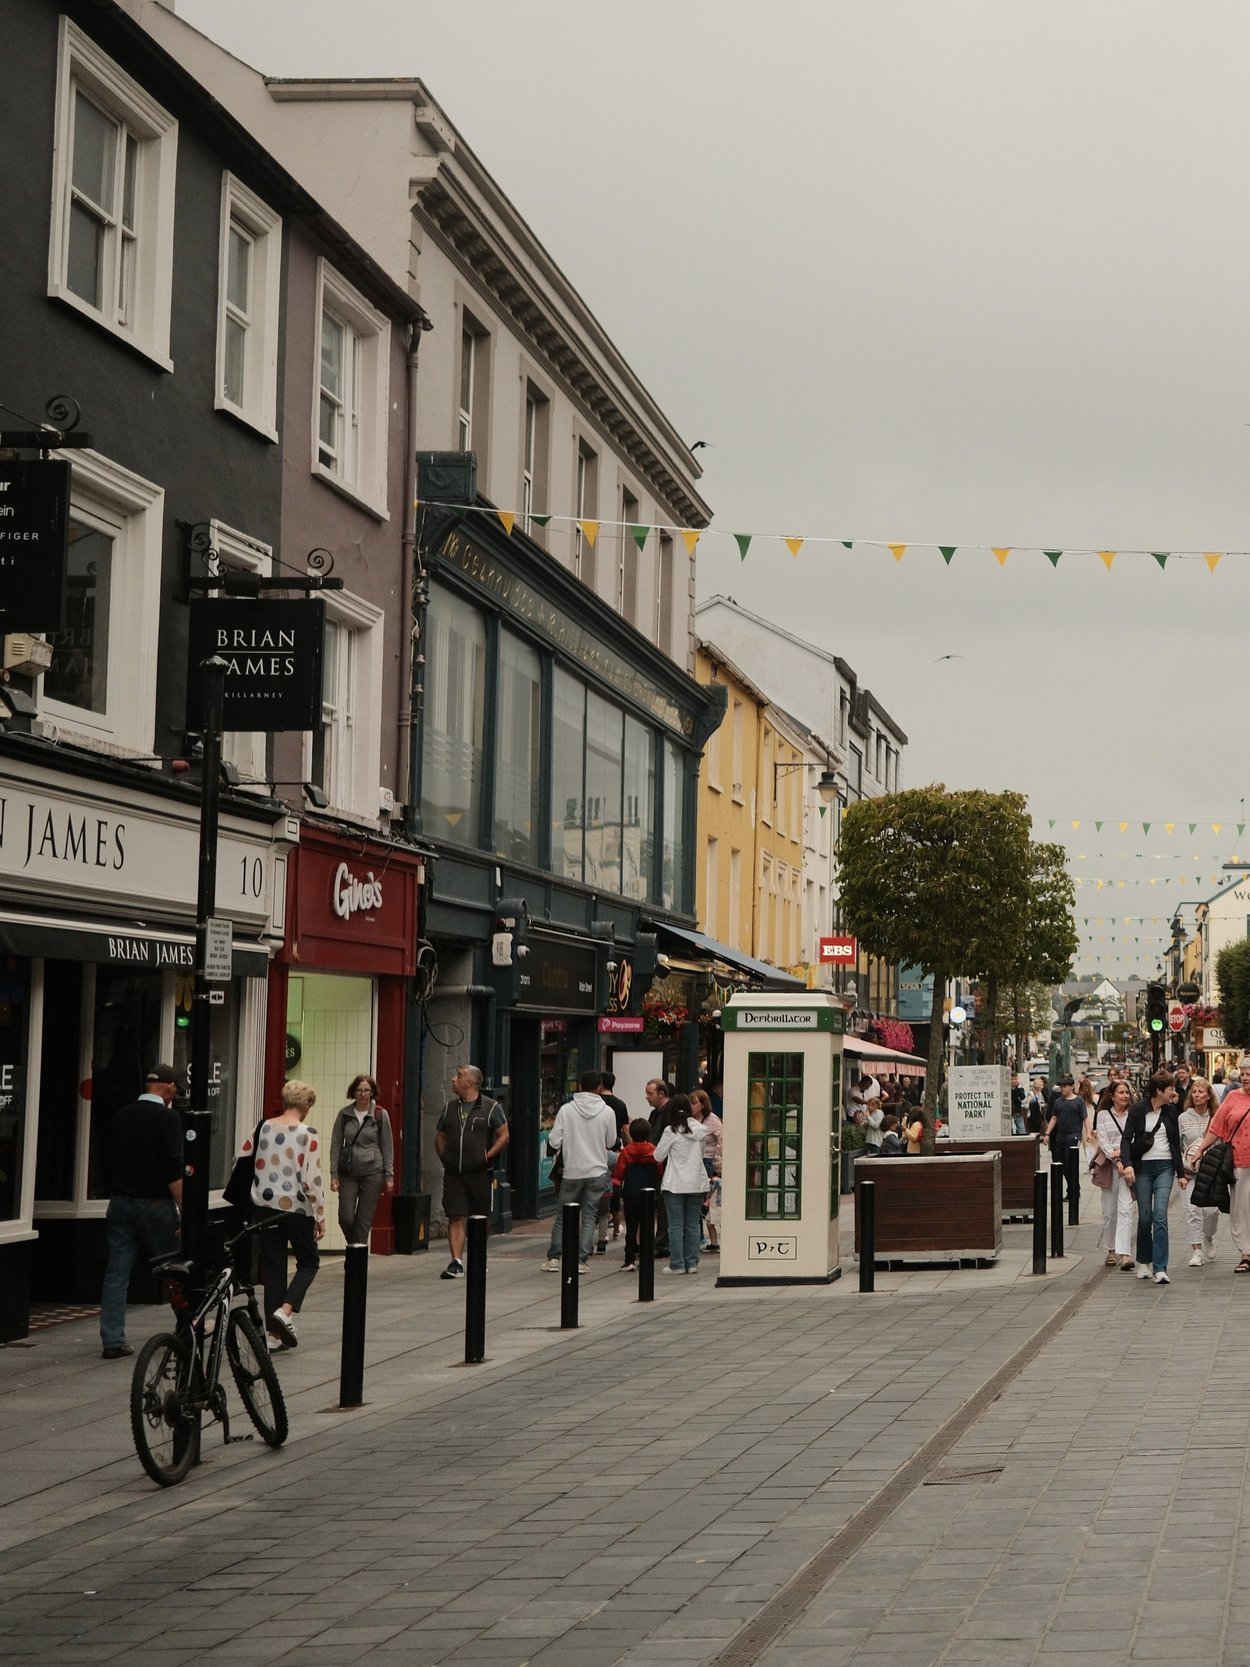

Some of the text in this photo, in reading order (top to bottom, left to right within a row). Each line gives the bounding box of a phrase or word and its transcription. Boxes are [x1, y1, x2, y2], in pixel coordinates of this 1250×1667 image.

[217, 629, 295, 647] BRIAN
[225, 658, 295, 676] AMES
[23, 804, 126, 870] JAMES
[240, 856, 263, 897] 10
[334, 862, 383, 920] Gino's
[108, 937, 149, 961] BRIAN
[156, 943, 194, 967] JAMES
[822, 945, 853, 956] EBS
[612, 1021, 641, 1030] Payzone
[1170, 1014, 1184, 1024] STOP
[955, 1092, 982, 1100] PROTECT
[957, 1100, 992, 1109] NATIONAL
[965, 1110, 986, 1119] PARK!
